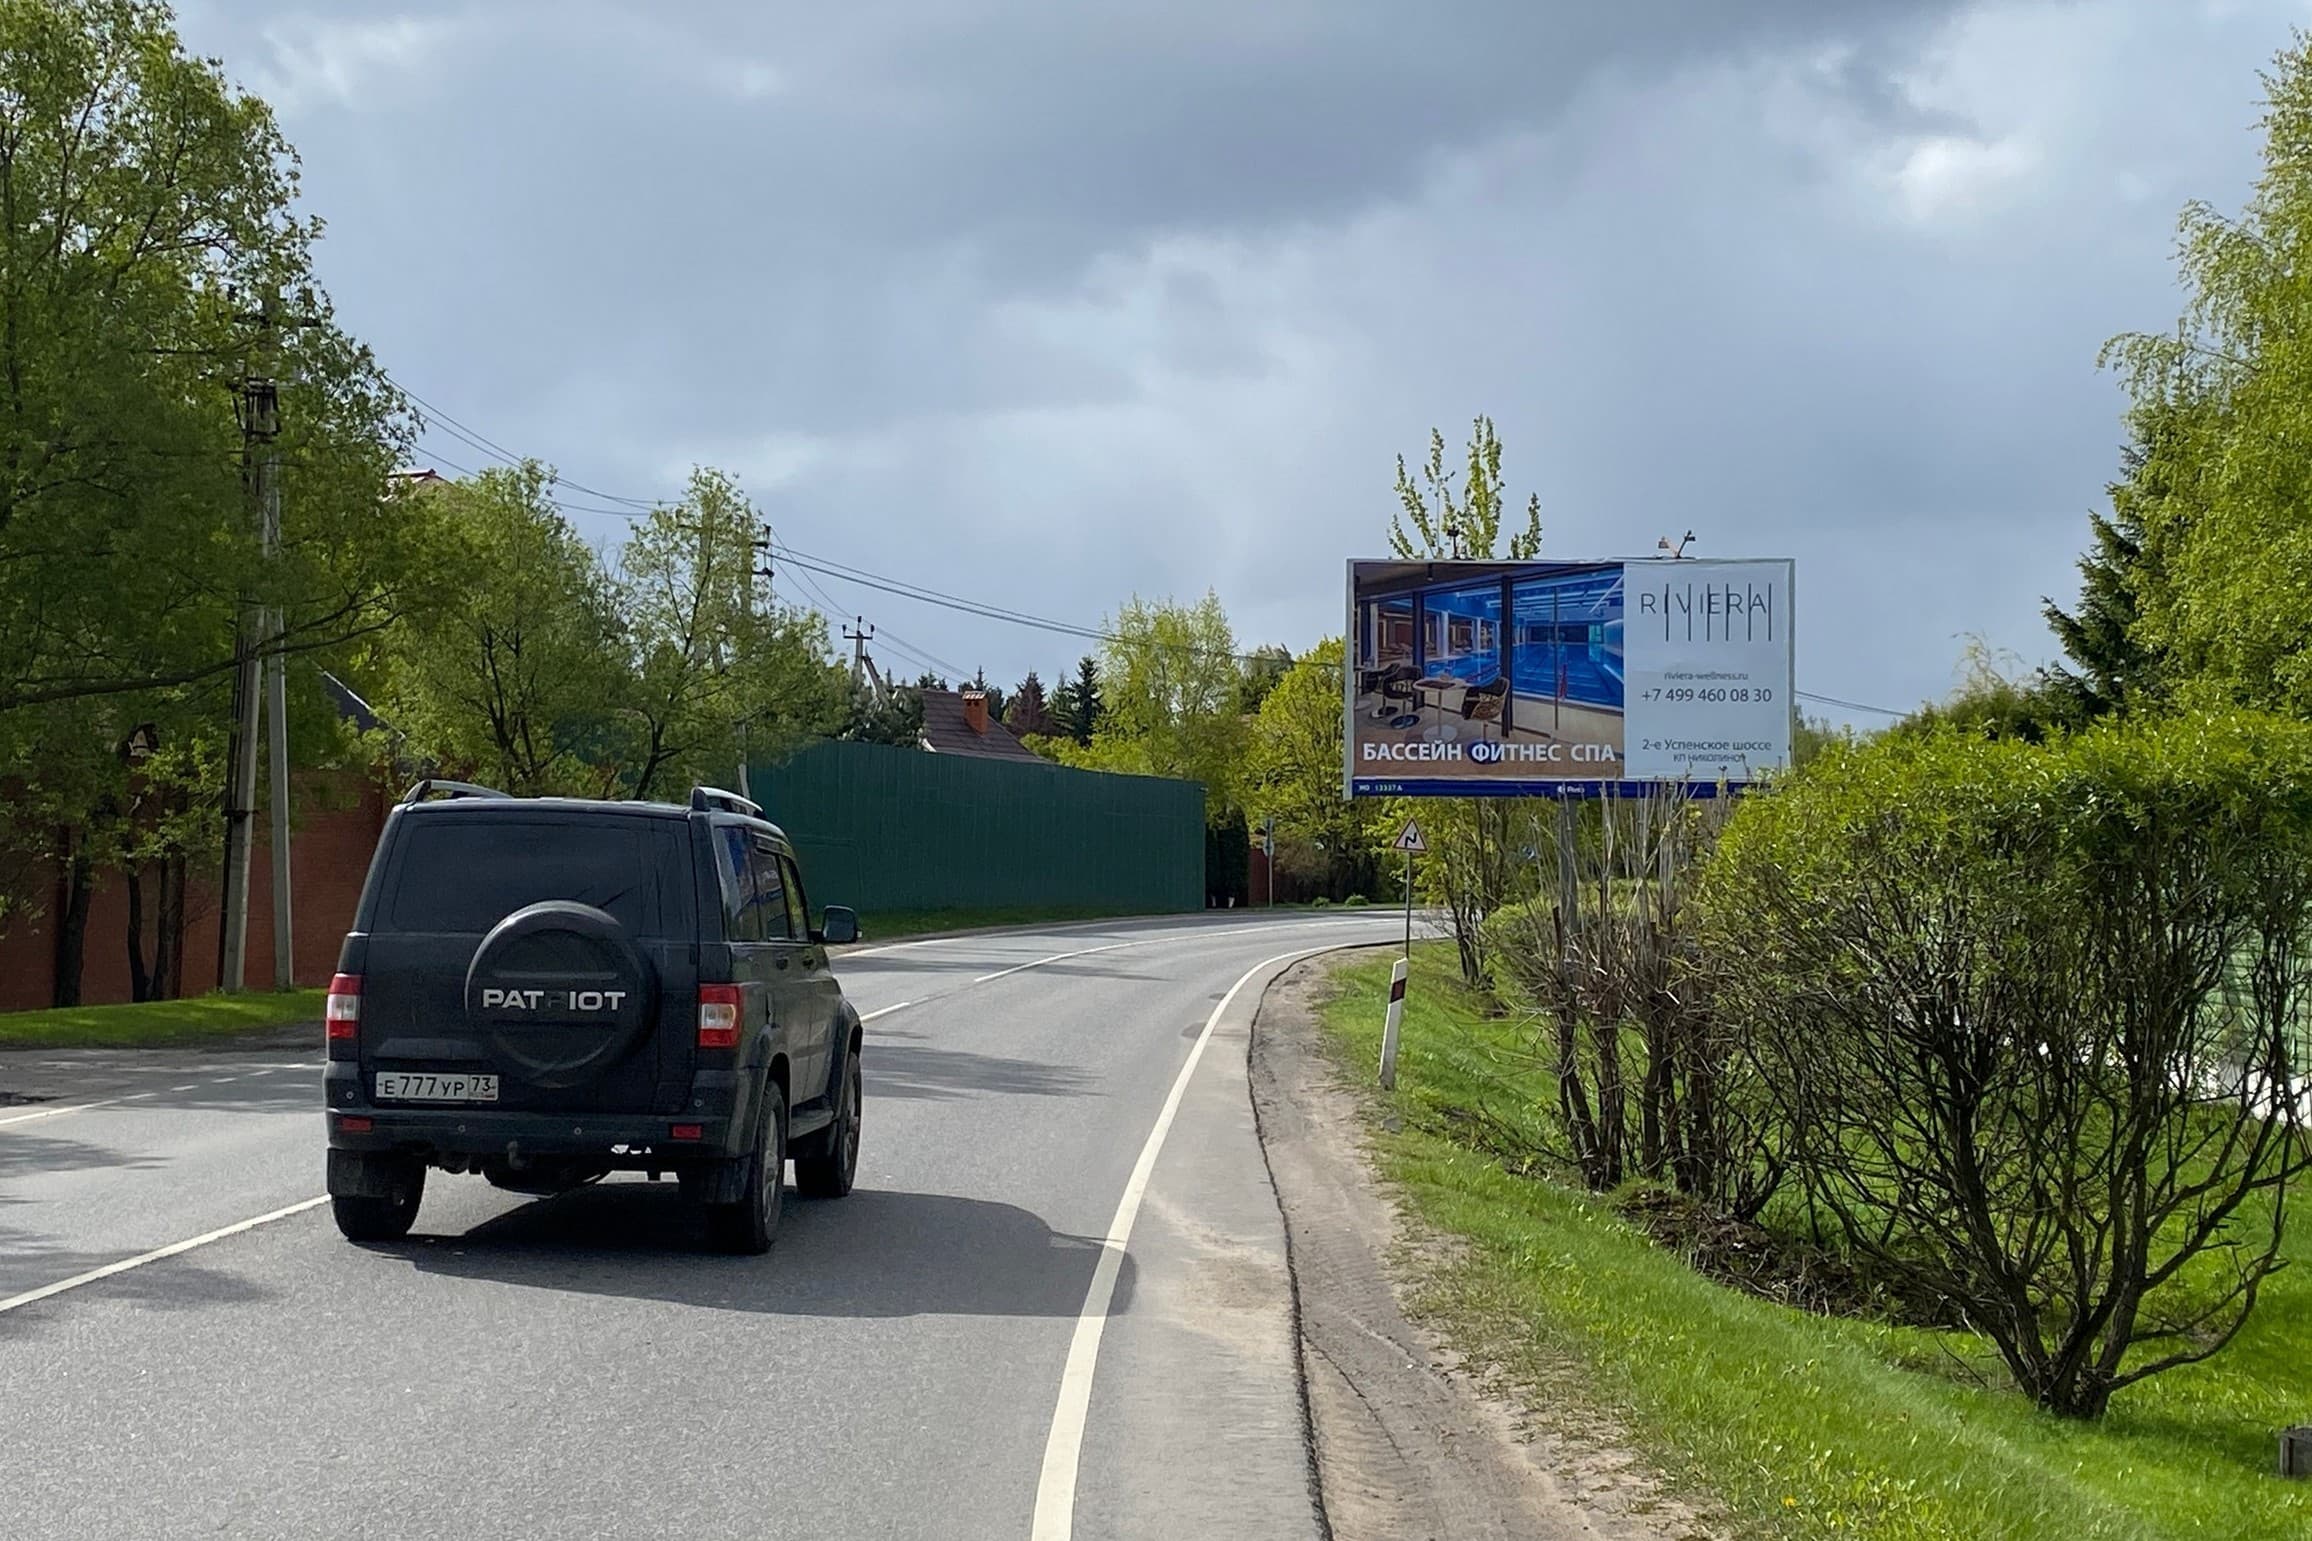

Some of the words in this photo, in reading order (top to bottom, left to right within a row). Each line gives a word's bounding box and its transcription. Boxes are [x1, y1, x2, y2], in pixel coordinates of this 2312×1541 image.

[1640, 592, 1767, 615] RIVIERA
[1664, 671, 1749, 681] riviera-wellness.ru
[1642, 688, 1661, 702] +7
[1665, 688, 1694, 702] 499
[1698, 688, 1726, 702] 460
[1730, 688, 1749, 702] 08
[1753, 688, 1772, 702] 30
[1363, 740, 1462, 761] БАССЕЙН
[1471, 743, 1561, 762] ФИТНЕС
[1570, 743, 1616, 762] СПА
[1642, 739, 1662, 750] 2-е
[1664, 739, 1730, 751] Успенское
[1733, 741, 1772, 751] шоссе
